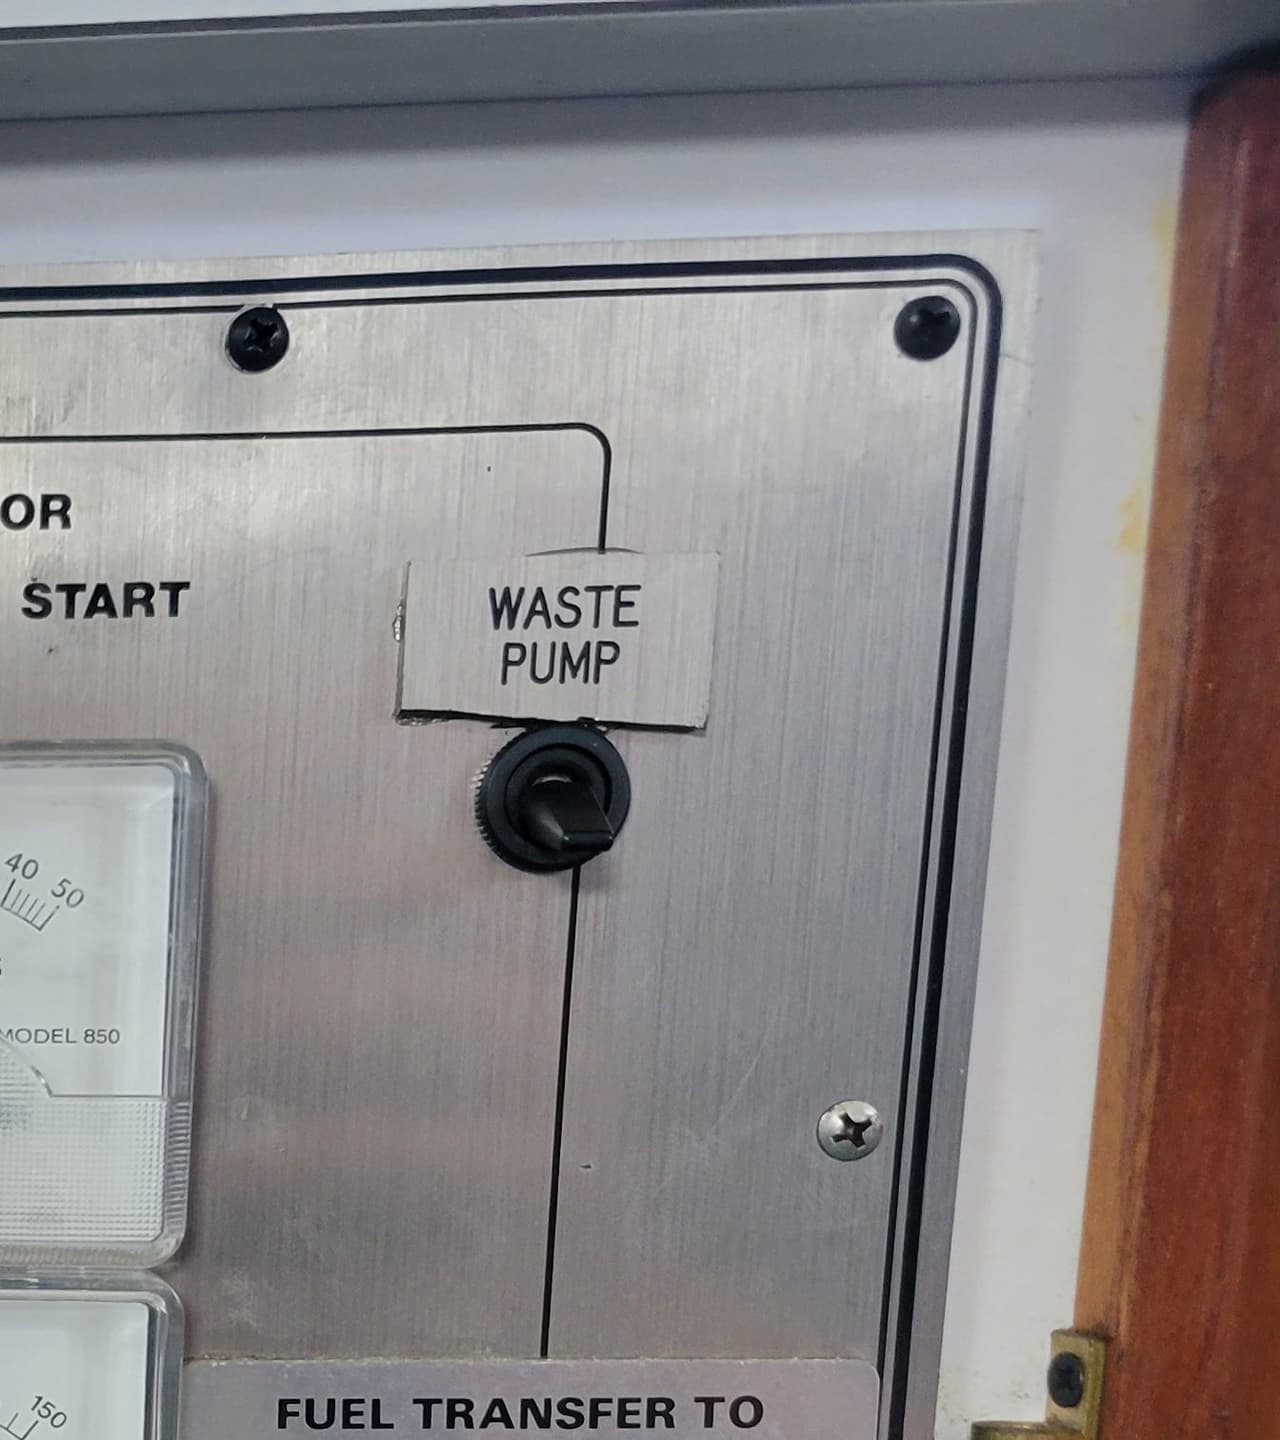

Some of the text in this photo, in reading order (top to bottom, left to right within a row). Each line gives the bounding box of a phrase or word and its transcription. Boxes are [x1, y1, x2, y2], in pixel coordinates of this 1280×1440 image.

[21, 581, 190, 619] START
[489, 585, 641, 630] WASTE
[501, 641, 620, 685] PUMP
[4, 853, 40, 881] 40
[51, 878, 85, 909] 50
[83, 1028, 121, 1044] 850
[29, 1395, 68, 1430] 150
[277, 1396, 764, 1430] FUEL TRANSFER TO
